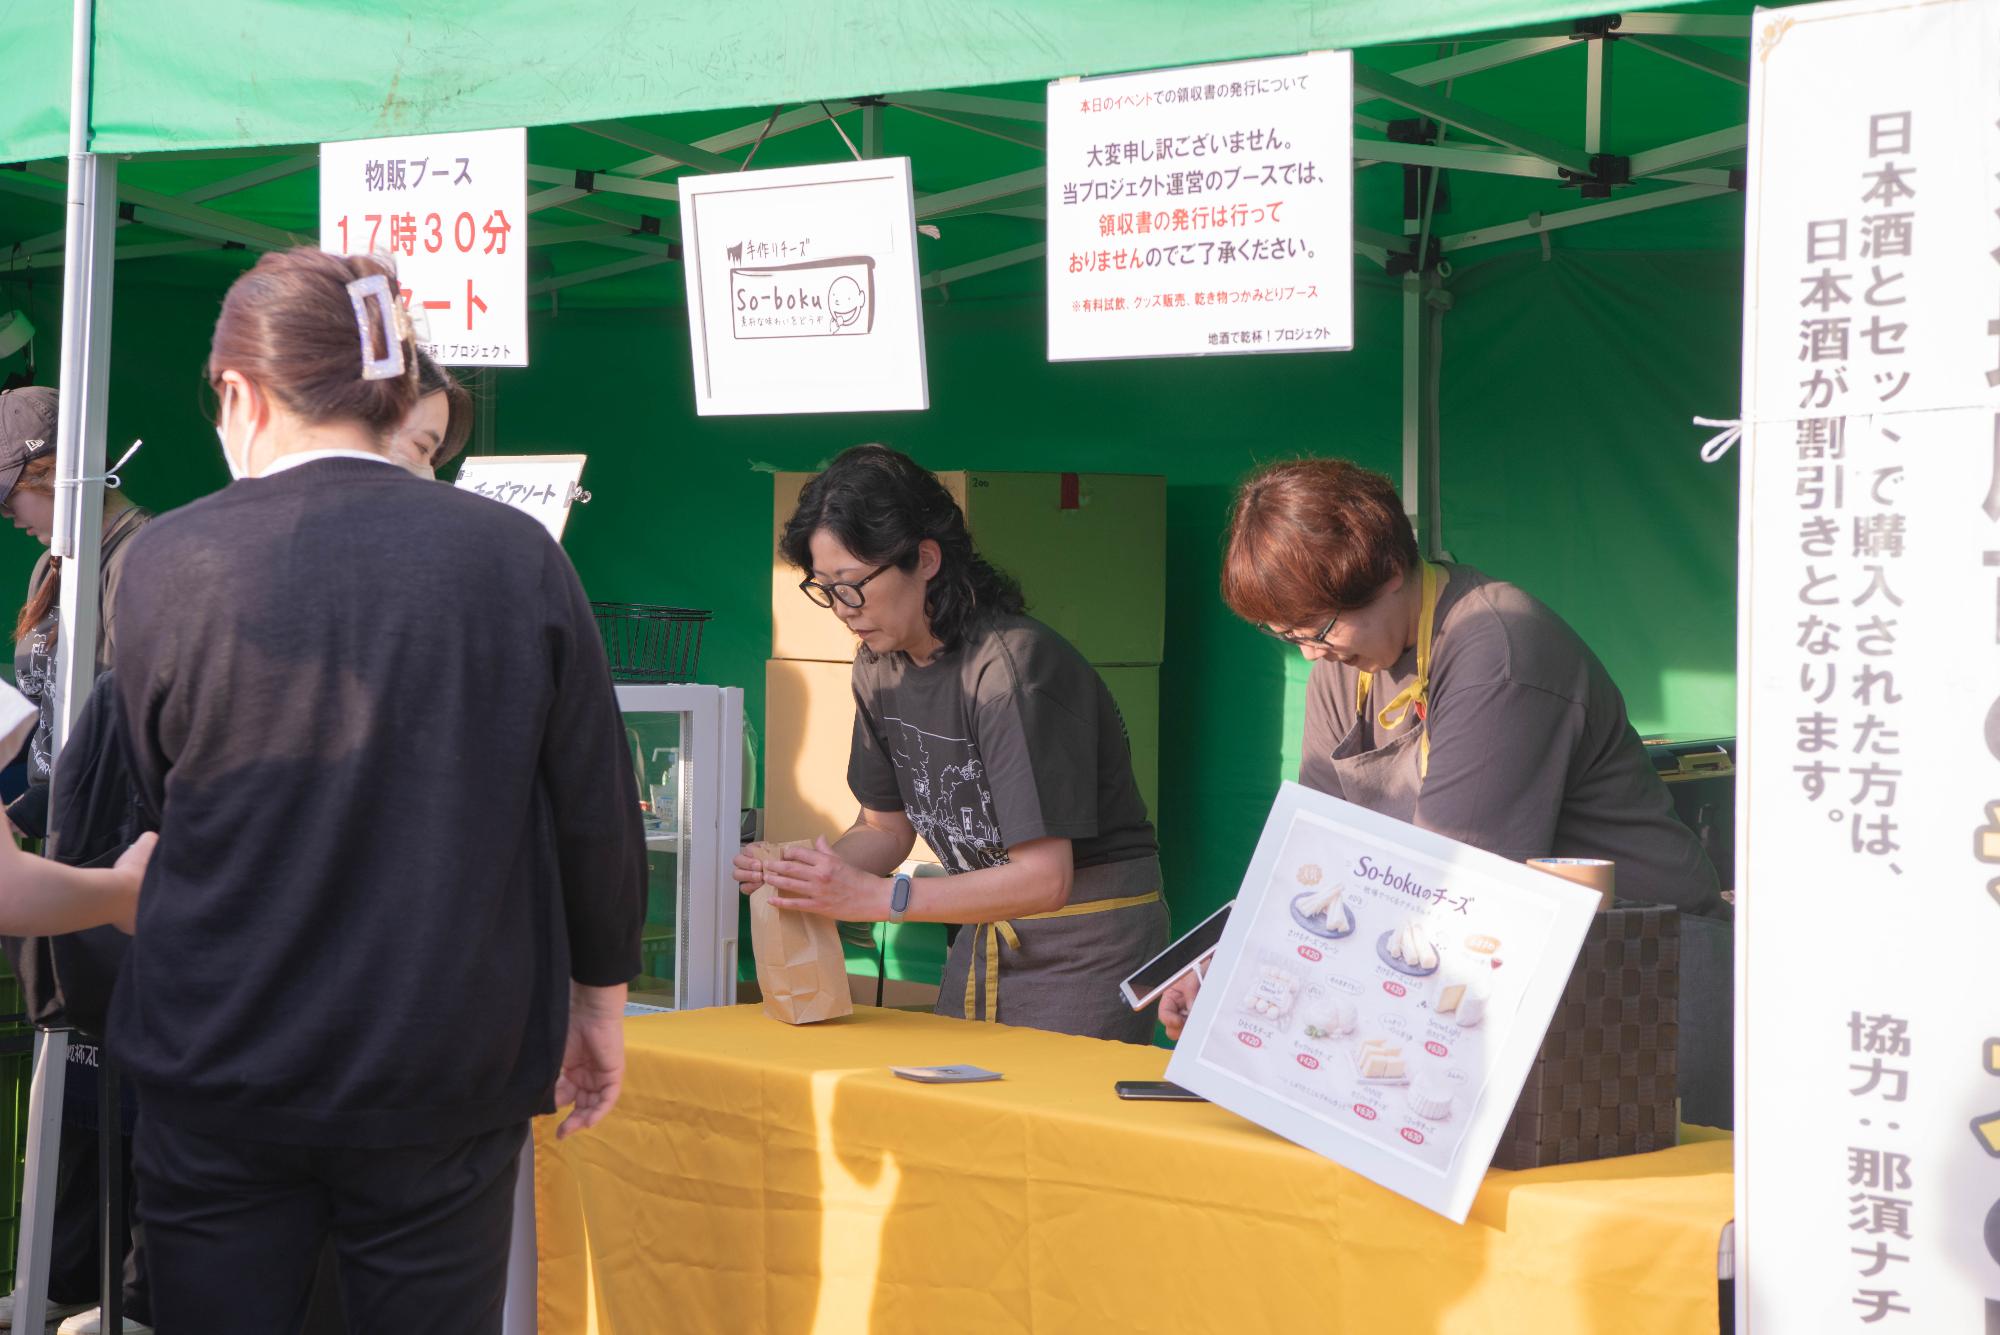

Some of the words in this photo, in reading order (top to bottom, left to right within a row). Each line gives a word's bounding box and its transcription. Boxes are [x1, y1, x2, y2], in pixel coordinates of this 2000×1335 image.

[1080, 75, 1310, 113] 本日のイベントでの領収書の発行について
[1087, 127, 1291, 167] 大変申し訳ございません。
[365, 156, 473, 191] 物販ブース
[1063, 161, 1324, 205] 当プロジェクト運営のブースでは、
[337, 209, 512, 256] 17時30分
[1099, 200, 1284, 237] 領収書の発行は行って
[746, 237, 810, 260] 手作りチーズ
[1069, 237, 1315, 273] おりませんのでご了承ください。
[737, 285, 822, 311] So-boku
[1208, 327, 1331, 346] 地酒で乾杯！プロジェクト
[1793, 218, 1852, 822] 日本酒が割引きとなります。
[1353, 856, 1475, 915] So-bokuのチーズ
